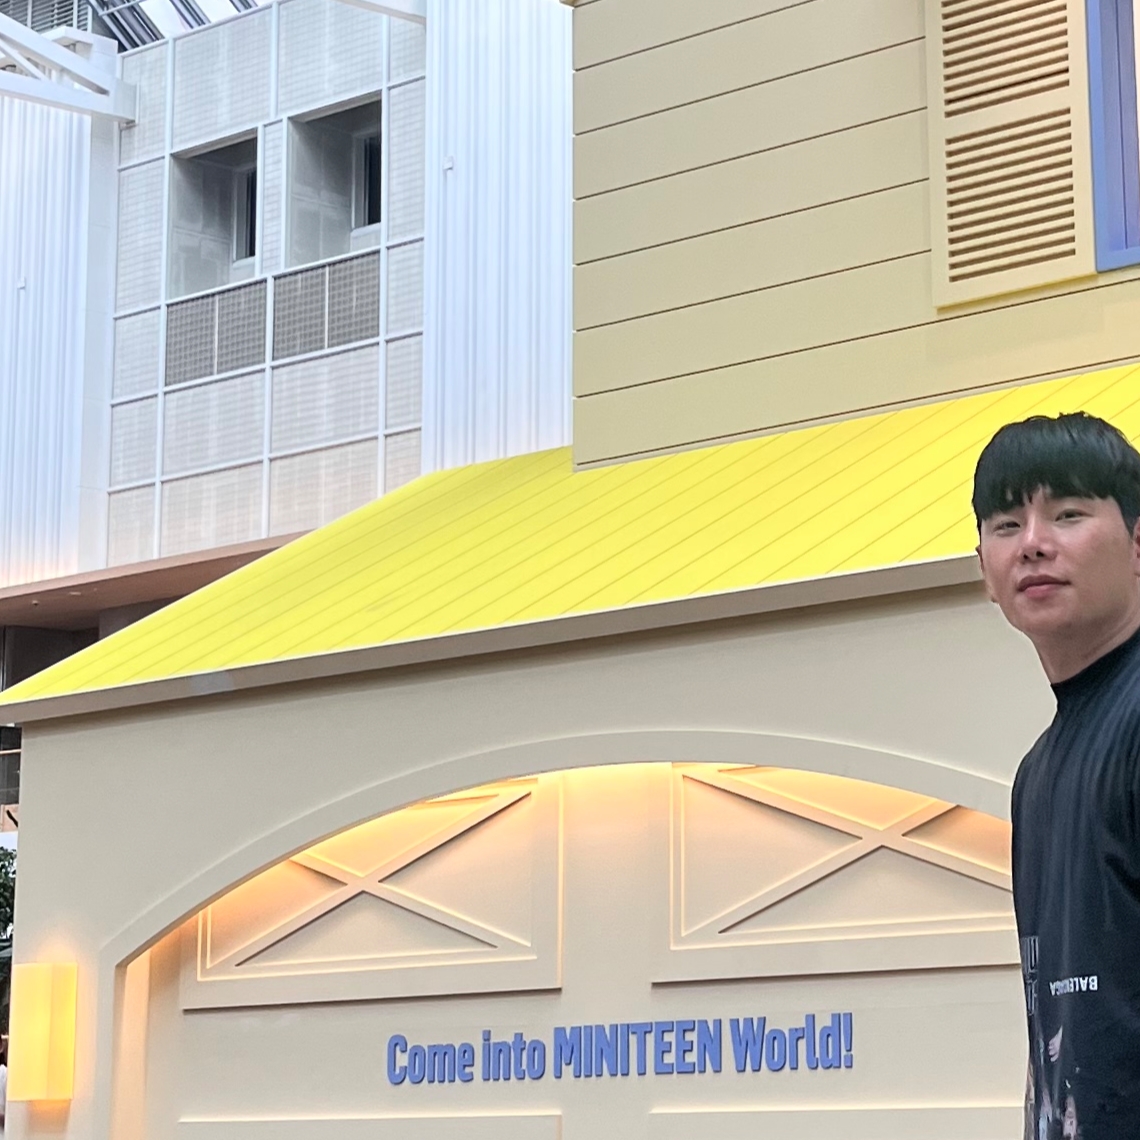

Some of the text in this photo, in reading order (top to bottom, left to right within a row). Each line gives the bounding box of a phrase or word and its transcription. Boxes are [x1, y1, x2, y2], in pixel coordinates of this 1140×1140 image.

[1049, 975, 1098, 996] BALEA
[386, 1012, 854, 1085] Come into MINITEEN World!
